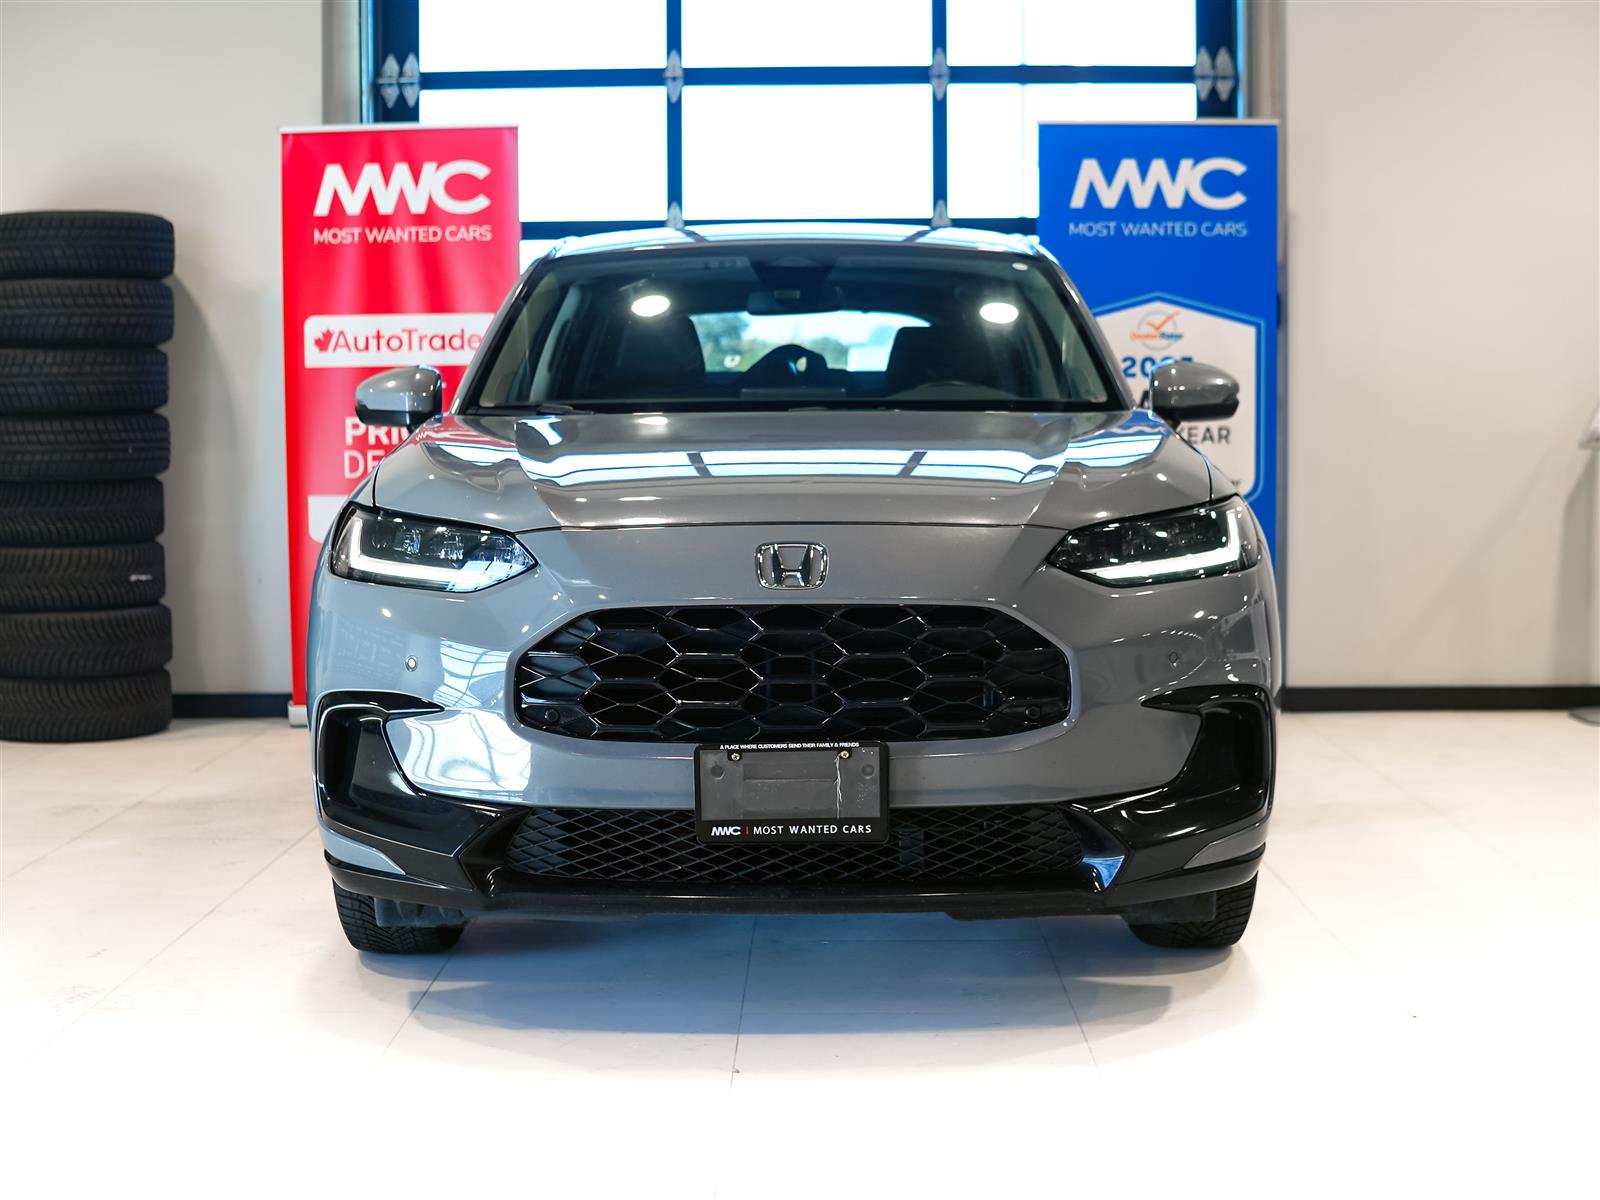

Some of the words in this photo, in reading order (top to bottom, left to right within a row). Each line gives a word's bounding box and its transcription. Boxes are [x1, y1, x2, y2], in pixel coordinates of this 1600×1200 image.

[313, 159, 492, 217] MWC
[1069, 157, 1248, 210] MWC
[313, 227, 361, 245] MOST
[365, 226, 443, 244] WANTED
[445, 225, 492, 242] CARS
[1069, 222, 1117, 237] MOST
[1121, 222, 1197, 237] WANTED
[1201, 222, 1248, 237] CARS
[1122, 356, 1193, 378] 20
[711, 826, 742, 836] MWC
[753, 826, 784, 835] MOST
[789, 825, 838, 834] WANTED
[842, 824, 872, 834] CARS
